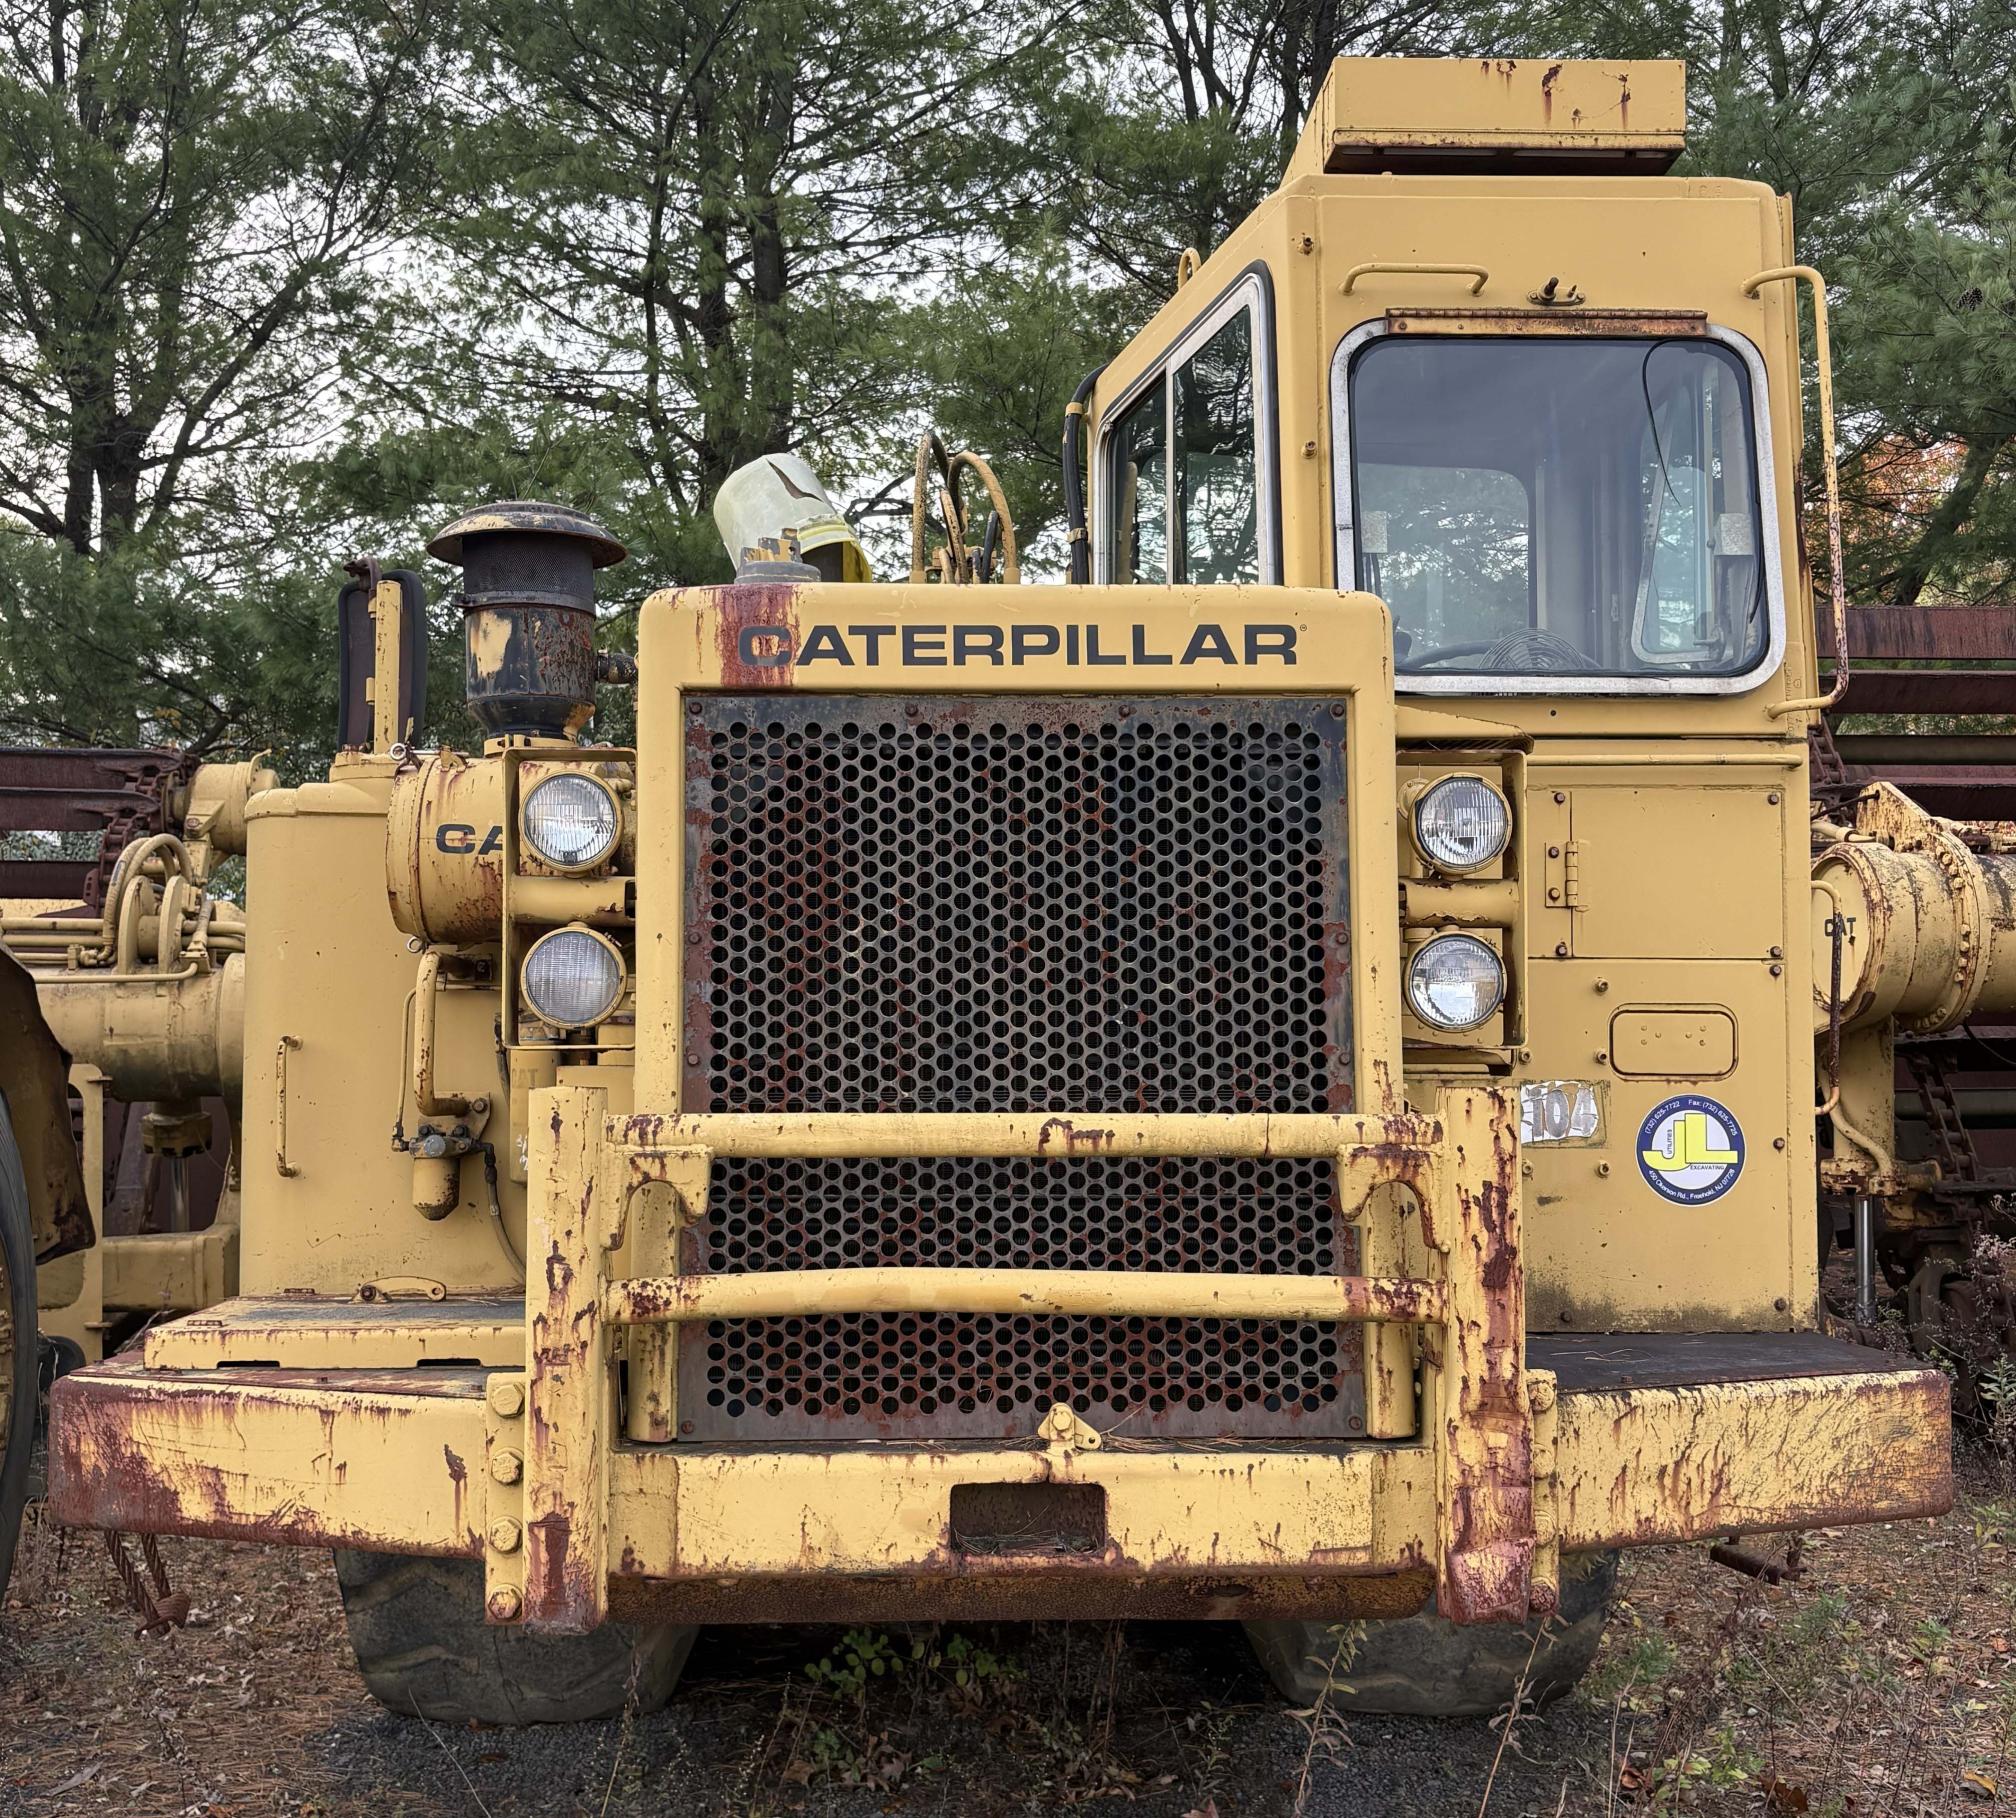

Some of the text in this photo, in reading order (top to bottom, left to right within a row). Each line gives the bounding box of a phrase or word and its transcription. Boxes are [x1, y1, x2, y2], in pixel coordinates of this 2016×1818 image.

[738, 623, 1298, 668] CATERPILLAR
[1521, 1087, 1598, 1138] 104
[1702, 1102, 1719, 1114] (732)
[1642, 1112, 1738, 1171] JL
[1714, 1182, 1724, 1192] NJ
